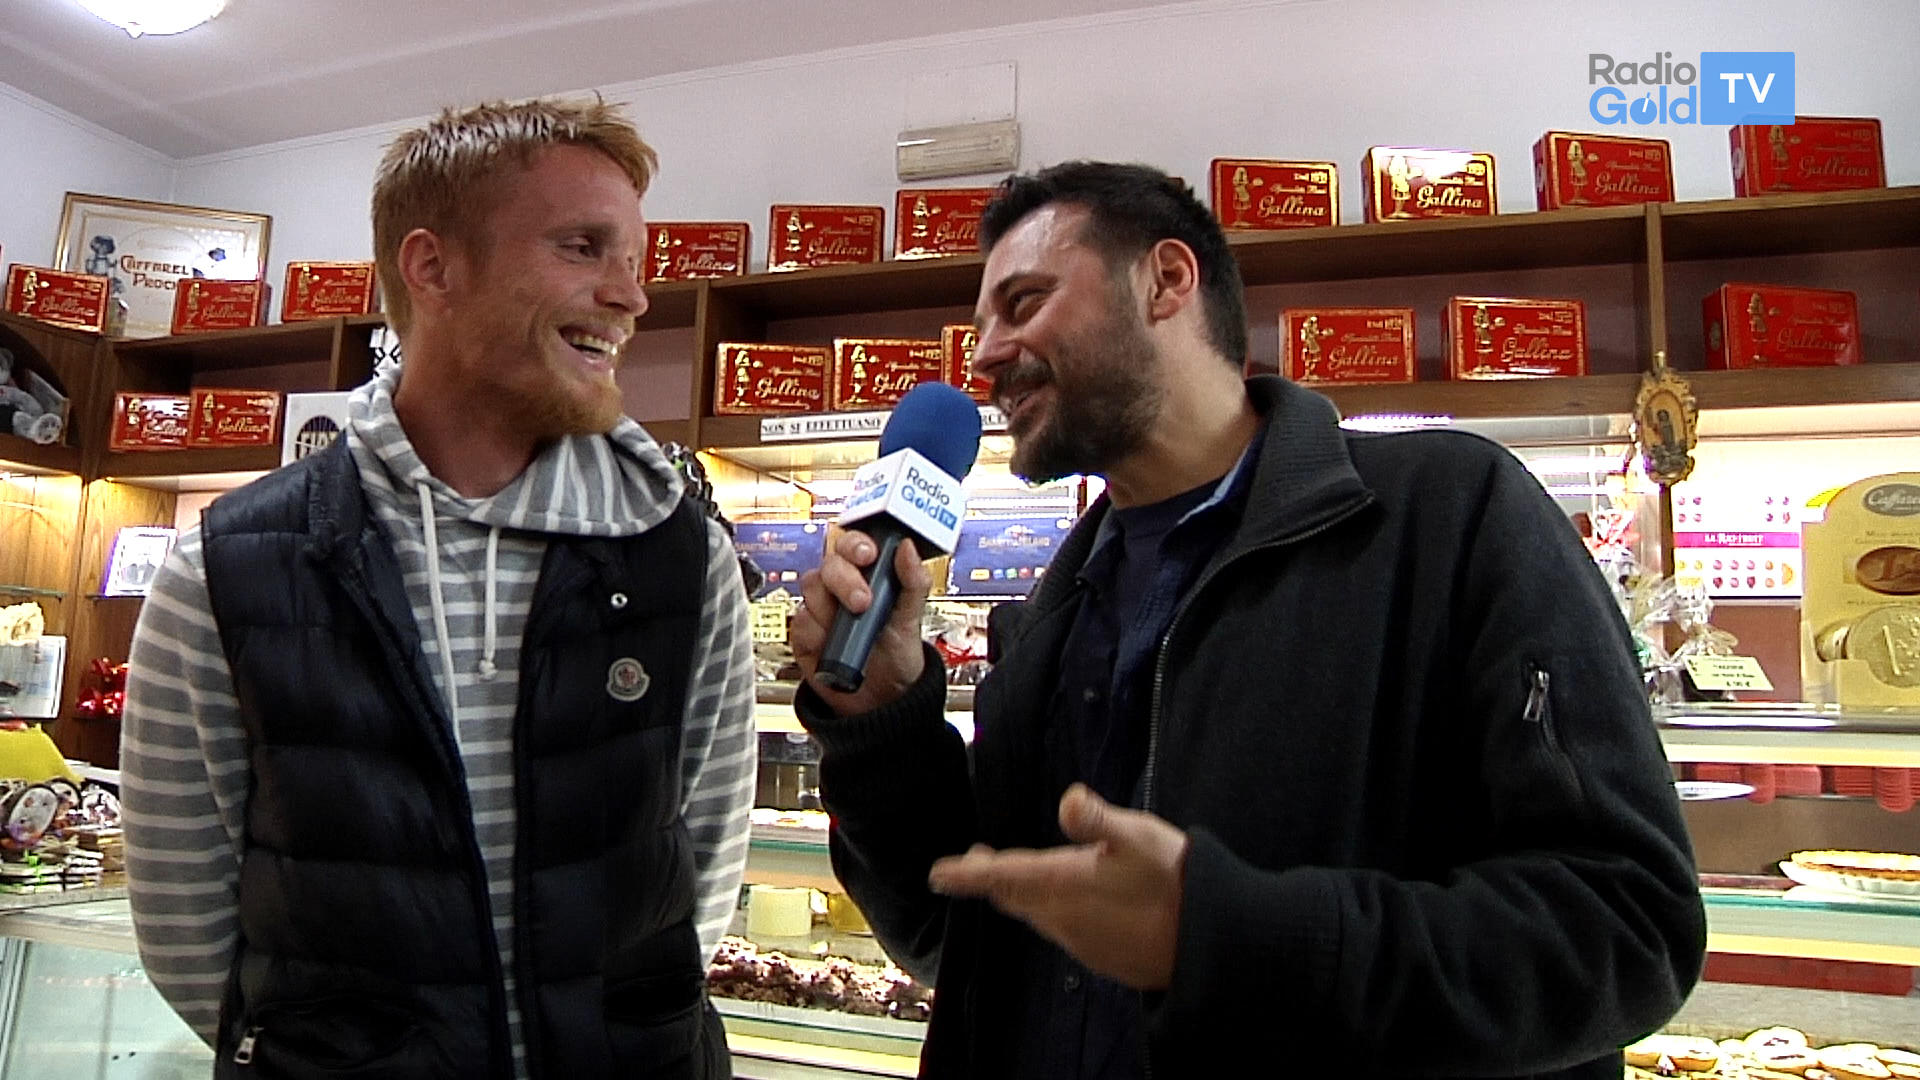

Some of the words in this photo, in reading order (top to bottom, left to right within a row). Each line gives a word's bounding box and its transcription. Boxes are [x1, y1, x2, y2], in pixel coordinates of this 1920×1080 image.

[1257, 195, 1327, 218] Gallina
[1416, 185, 1483, 209] Gallina
[1327, 345, 1399, 371] Gallina
[1501, 337, 1574, 362] Gallina
[755, 376, 820, 399] Gallina
[906, 466, 950, 505] Radio
[901, 485, 940, 519] Gold
